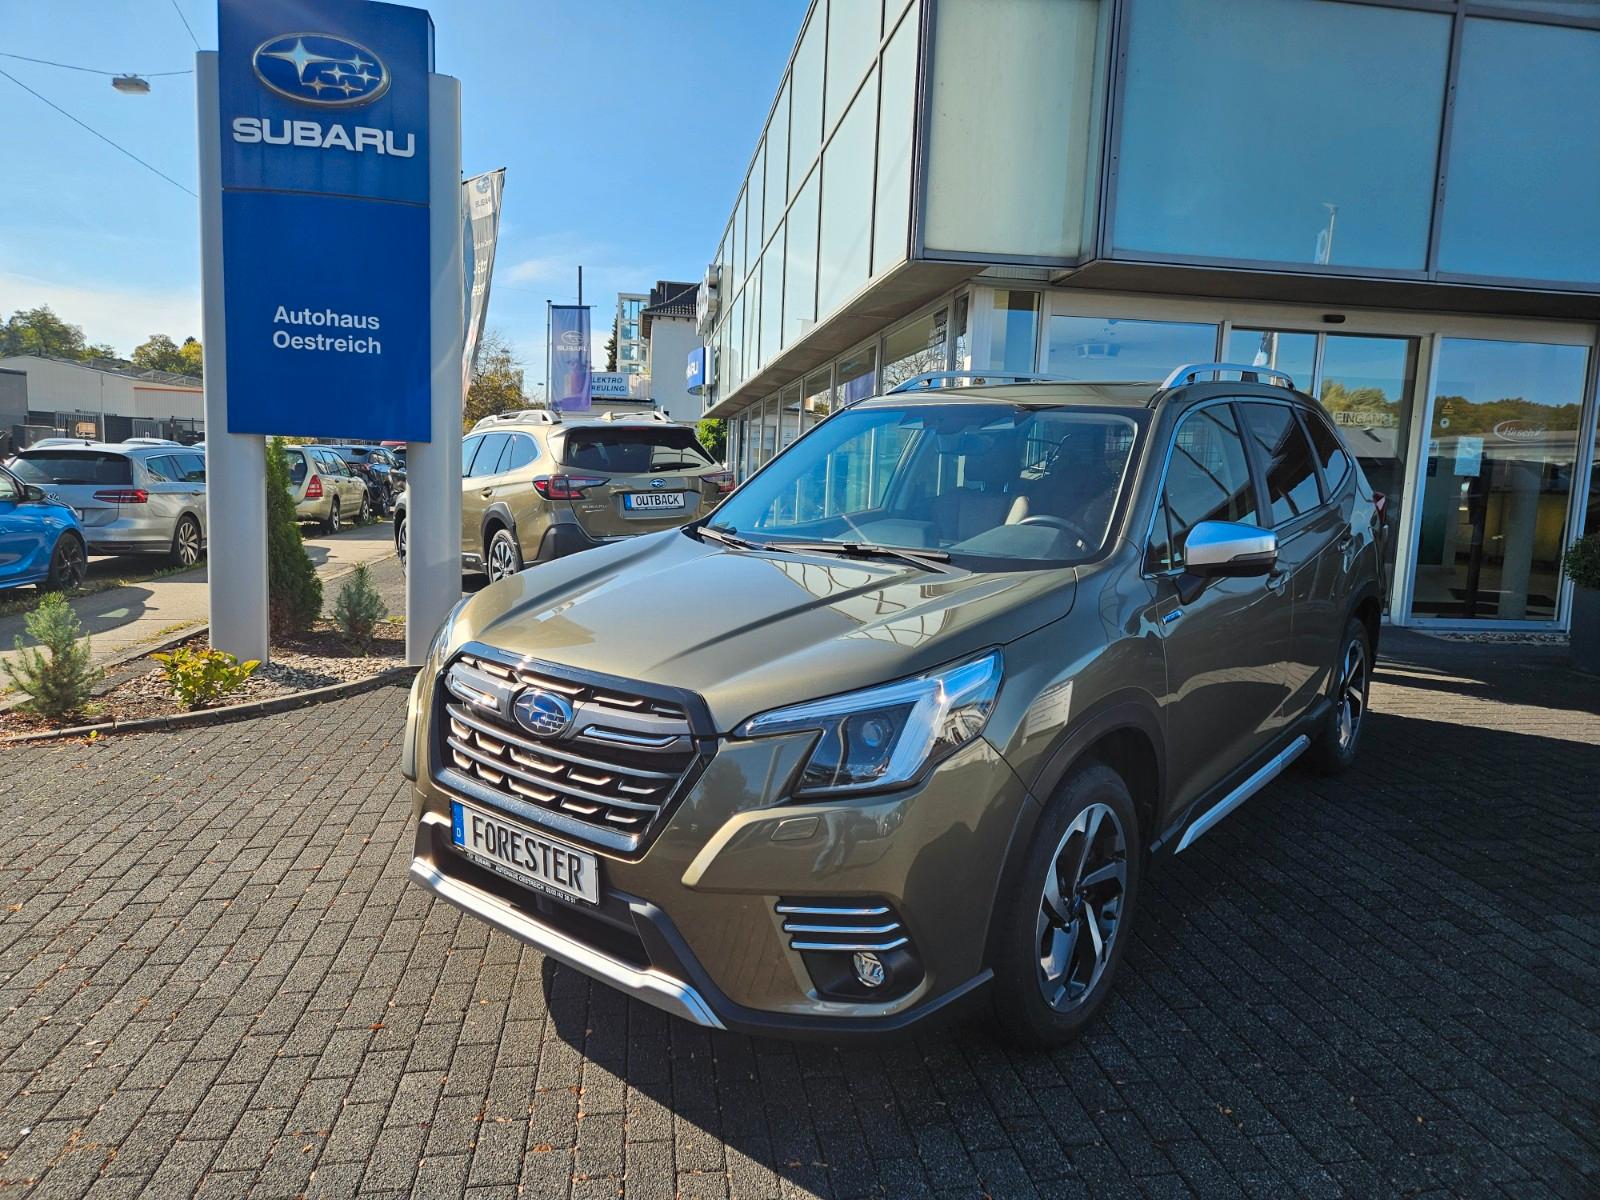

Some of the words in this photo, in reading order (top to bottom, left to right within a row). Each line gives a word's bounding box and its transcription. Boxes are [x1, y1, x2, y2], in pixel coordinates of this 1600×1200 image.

[232, 117, 416, 158] SUBARU
[273, 305, 380, 330] Autohaus
[272, 330, 382, 355] Oestreich
[1335, 412, 1390, 426] EINGANG
[635, 494, 680, 506] OUTBACK
[456, 827, 462, 838] D
[472, 815, 582, 892] FORESTER
